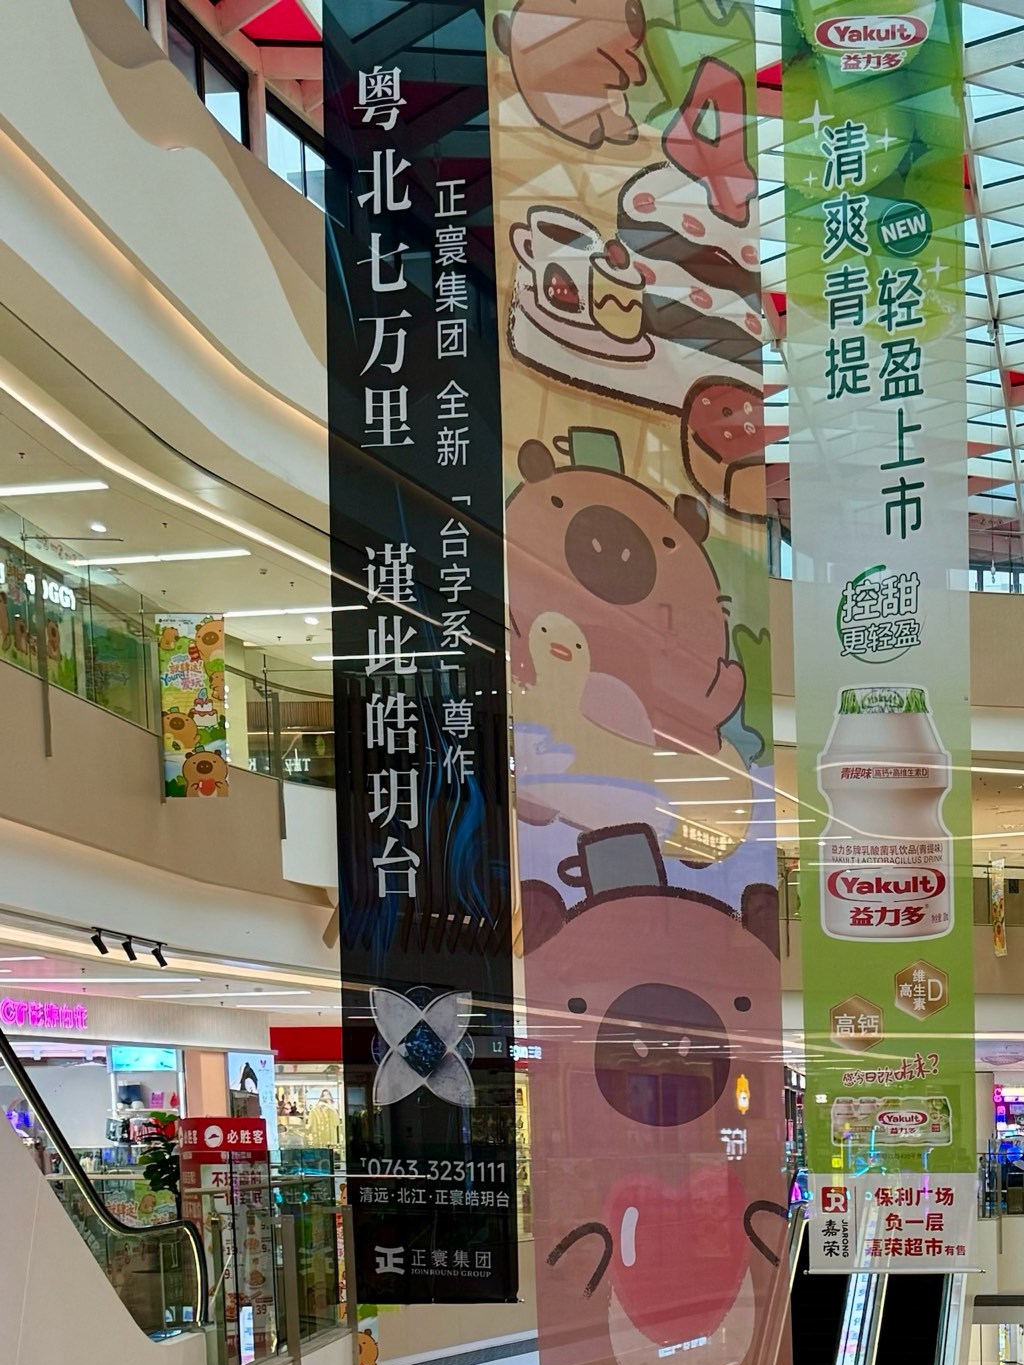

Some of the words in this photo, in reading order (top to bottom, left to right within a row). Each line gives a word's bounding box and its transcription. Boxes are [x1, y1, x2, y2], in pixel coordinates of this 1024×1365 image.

[834, 24, 911, 42] Yakult
[842, 53, 902, 70] 益力多
[880, 212, 927, 244] NEW
[353, 66, 415, 449] 粤北七万里
[822, 121, 872, 400] 清爽青提
[434, 179, 468, 359] 正寰集团
[878, 270, 925, 539] 轻盈上市
[436, 381, 469, 466] 全新
[842, 572, 920, 623] 控甜
[840, 619, 921, 657] 更轻盈
[441, 698, 475, 784] 尊作
[841, 767, 872, 779] 青提味
[924, 856, 942, 864] DRINK
[841, 876, 935, 894] Yakult
[849, 906, 926, 927] 益力多
[835, 1013, 879, 1036] 高钙
[886, 1115, 920, 1124] Yakult
[227, 1129, 263, 1144] 必胜客
[427, 1160, 506, 1183] 3231111
[874, 1187, 954, 1207] 保利广场
[885, 1212, 944, 1232] 负一层
[841, 1219, 849, 1258] JIARONG
[411, 1248, 492, 1269] 正寰集团
[461, 1269, 492, 1278] GROUP
